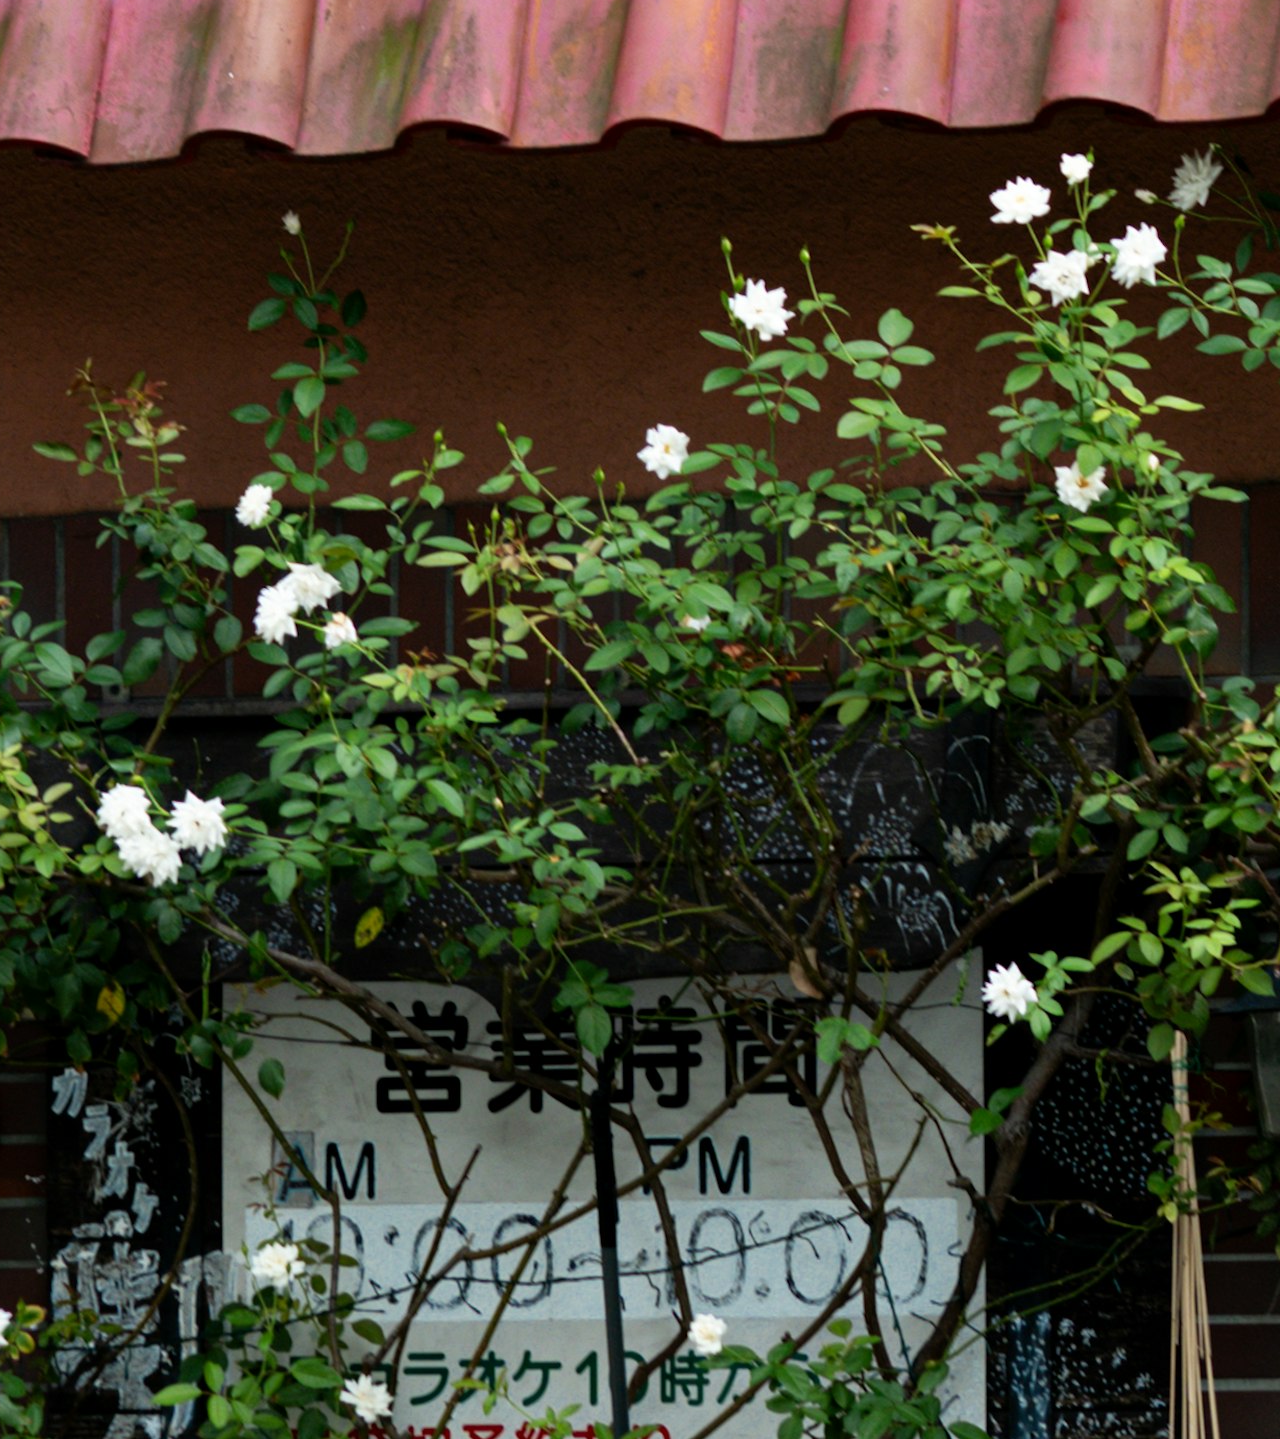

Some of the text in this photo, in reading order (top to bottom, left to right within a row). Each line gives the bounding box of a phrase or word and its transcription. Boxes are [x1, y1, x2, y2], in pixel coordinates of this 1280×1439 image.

[372, 995, 818, 1114] 営業時間
[51, 1066, 160, 1234] カラオケ
[276, 1135, 752, 1205] AM PM
